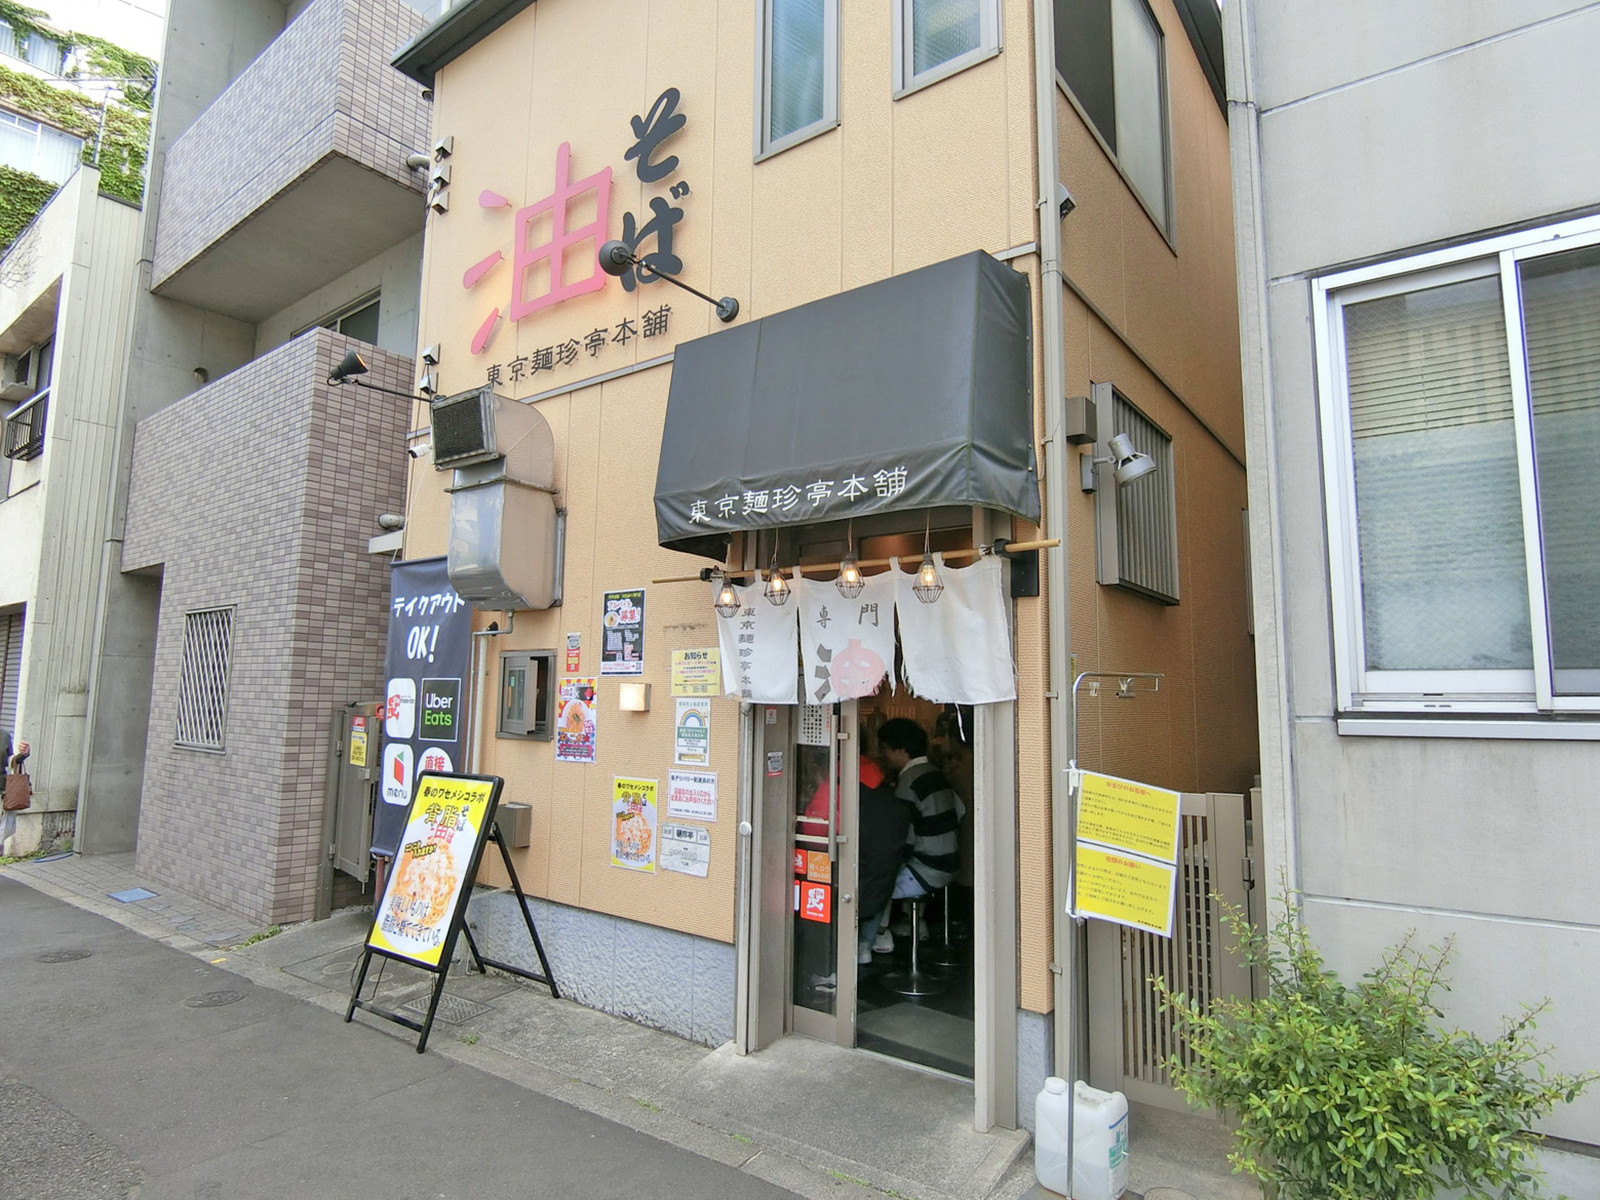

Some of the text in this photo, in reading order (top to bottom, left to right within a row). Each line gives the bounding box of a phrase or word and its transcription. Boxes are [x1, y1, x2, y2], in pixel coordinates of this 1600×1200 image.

[462, 87, 690, 355] 油 そば
[486, 304, 672, 386] 東京麺珍亭本舗
[689, 465, 908, 524] 東京麺珍亭本舗
[407, 624, 439, 664] OK!
[684, 651, 708, 660] お知らせ
[425, 692, 453, 710] Uber
[424, 709, 452, 727] Eats
[386, 787, 408, 800] menu
[423, 786, 486, 804] 春のワセメシコラボ
